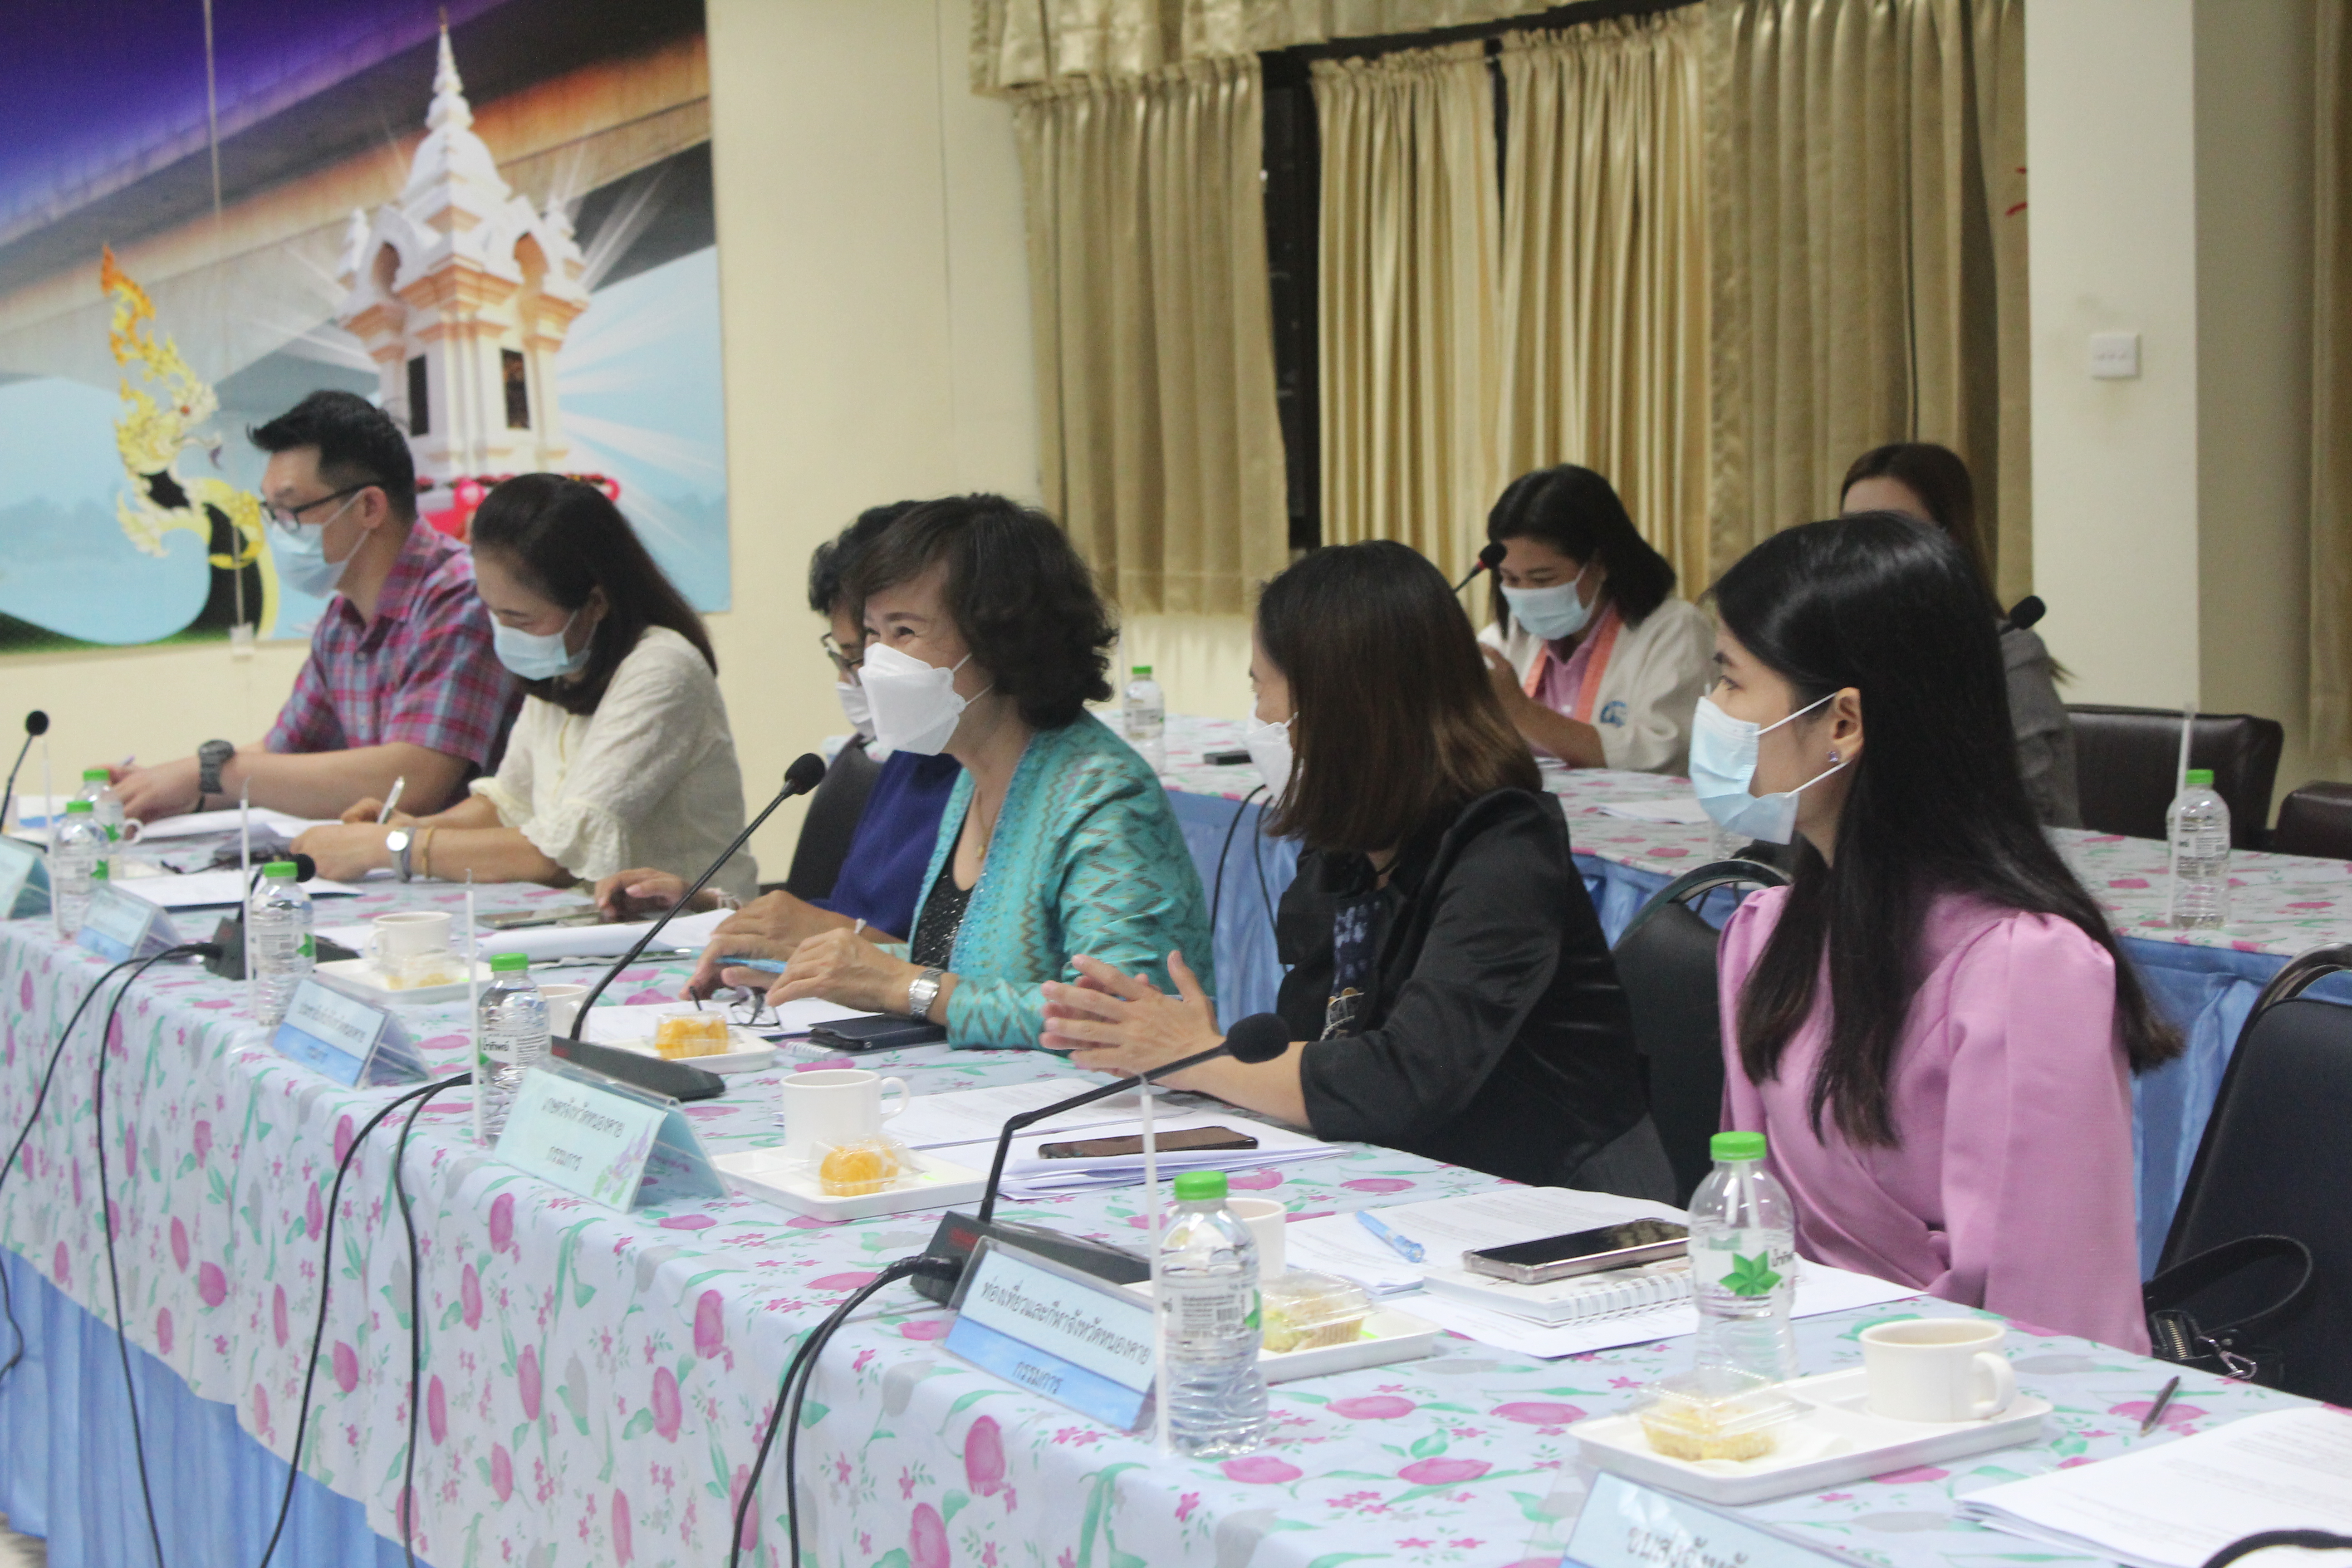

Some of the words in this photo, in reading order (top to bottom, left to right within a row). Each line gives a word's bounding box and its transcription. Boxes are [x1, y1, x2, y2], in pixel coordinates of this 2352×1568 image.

[980, 1275, 1152, 1365] ท่องเที่ยวและกีฬาจังหวัดหนองคาย
[1013, 1362, 1064, 1395] กรรมการ
